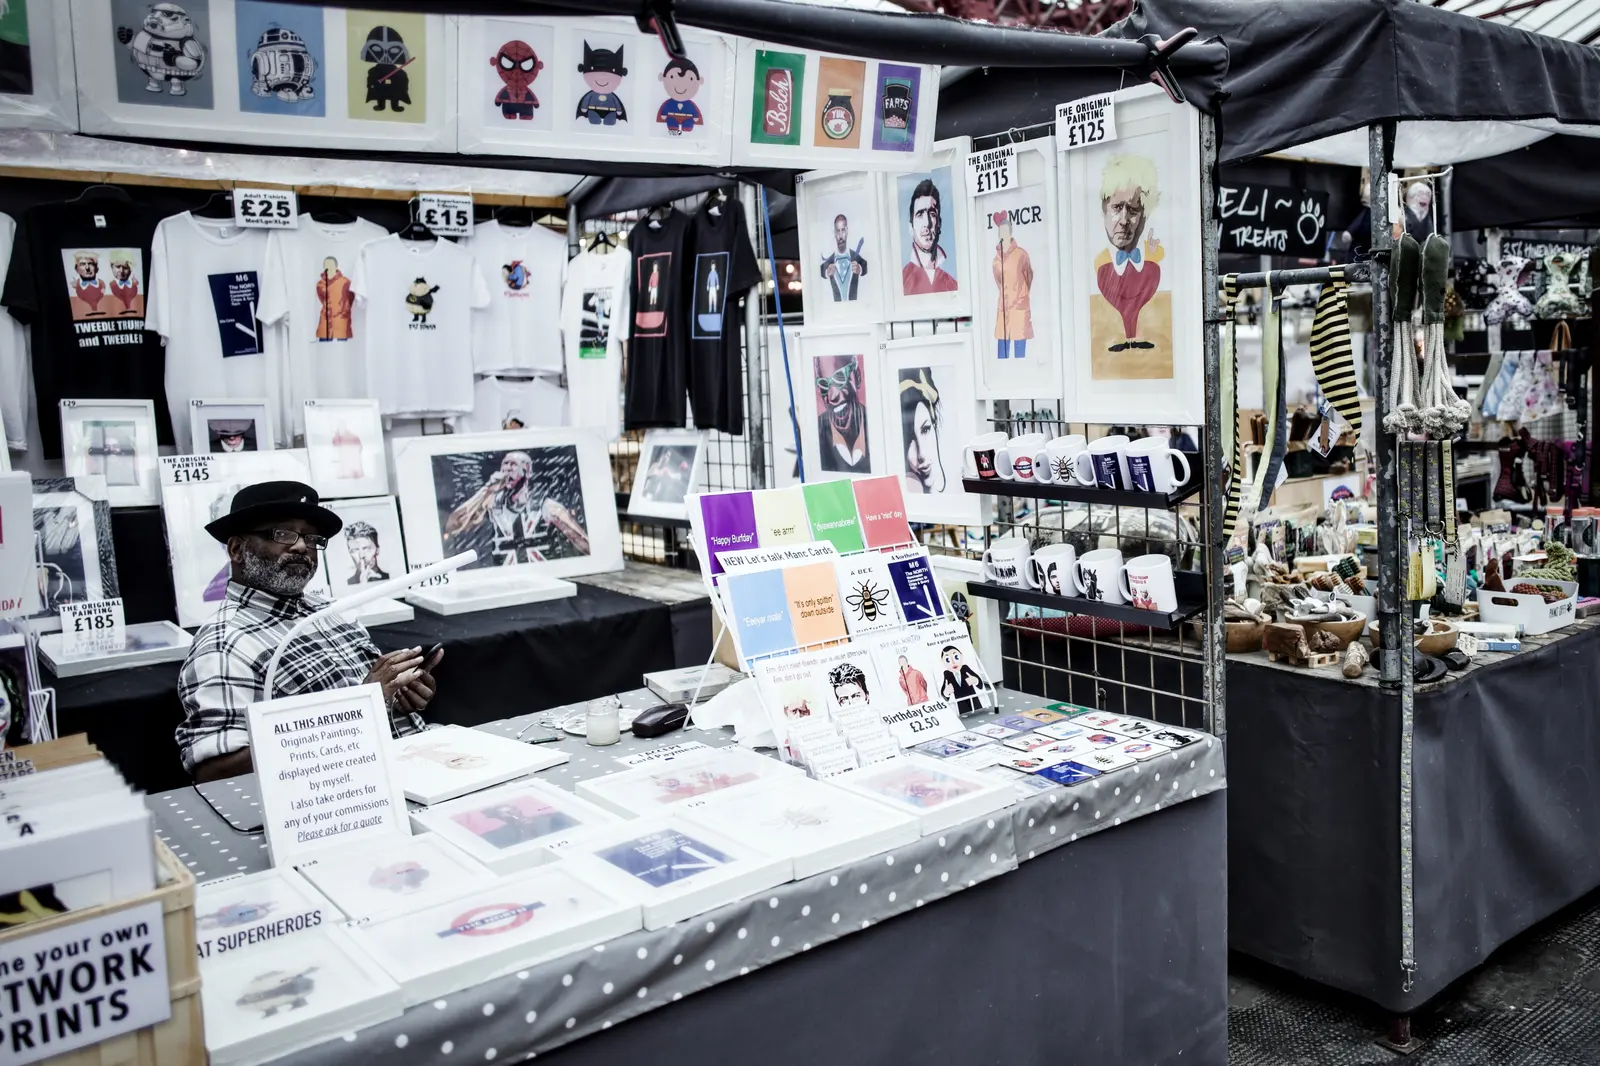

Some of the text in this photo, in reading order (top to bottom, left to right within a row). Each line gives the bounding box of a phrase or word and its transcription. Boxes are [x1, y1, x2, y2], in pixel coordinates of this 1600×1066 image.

[766, 77, 789, 132] Belch
[884, 97, 909, 110] FARTS
[1059, 97, 1111, 118] THE ORIGINAL
[831, 109, 846, 119] YUK
[1066, 109, 1104, 125] PAINTING
[1068, 120, 1105, 147] £125
[968, 148, 1014, 166] THE ORIGINAL
[975, 158, 1008, 173] PAINTING
[976, 168, 1009, 193] £115
[241, 199, 291, 218] £25
[1217, 186, 1269, 222] ELI
[425, 208, 468, 226] £15
[987, 206, 1042, 229] I MCR
[1230, 225, 1288, 252] TREATS
[235, 274, 249, 282] M6
[74, 319, 145, 334] TWEEDLE TRUMP
[79, 336, 100, 348] and
[172, 461, 208, 469] PAINTING
[180, 455, 214, 463] ORIGINAL
[174, 468, 210, 483] £145
[711, 536, 731, 546] "Happy
[723, 546, 834, 567] NEW Let's talk Manc Cards
[908, 560, 920, 569] M6
[858, 567, 873, 575] BEE
[912, 567, 928, 576] NORTH
[72, 607, 113, 617] PAINTING
[82, 599, 121, 610] ORIGINAL
[800, 605, 834, 619] down outside
[805, 598, 816, 608] only
[74, 614, 115, 632] £185
[274, 709, 363, 735] ALL THIS ARTWORK
[882, 706, 923, 726] Birthday
[924, 700, 947, 714] Cards
[909, 716, 940, 733] £2.50
[280, 726, 363, 749] Originals Paintings,
[289, 741, 360, 762] Prints, Cards, etc
[629, 745, 707, 765] Card Payments
[278, 752, 377, 781] displayed were created
[309, 772, 353, 792] by myself.
[296, 797, 314, 809] also
[315, 792, 335, 805] take
[337, 786, 363, 800] orders
[364, 784, 377, 795] for
[284, 797, 389, 830] any of your commissions
[20, 822, 34, 837] A
[297, 815, 383, 843] Please ask for a quote
[217, 910, 322, 953] SUPERHEROES
[34, 938, 91, 972] your
[101, 922, 149, 947] own
[0, 943, 155, 1018] TWORK
